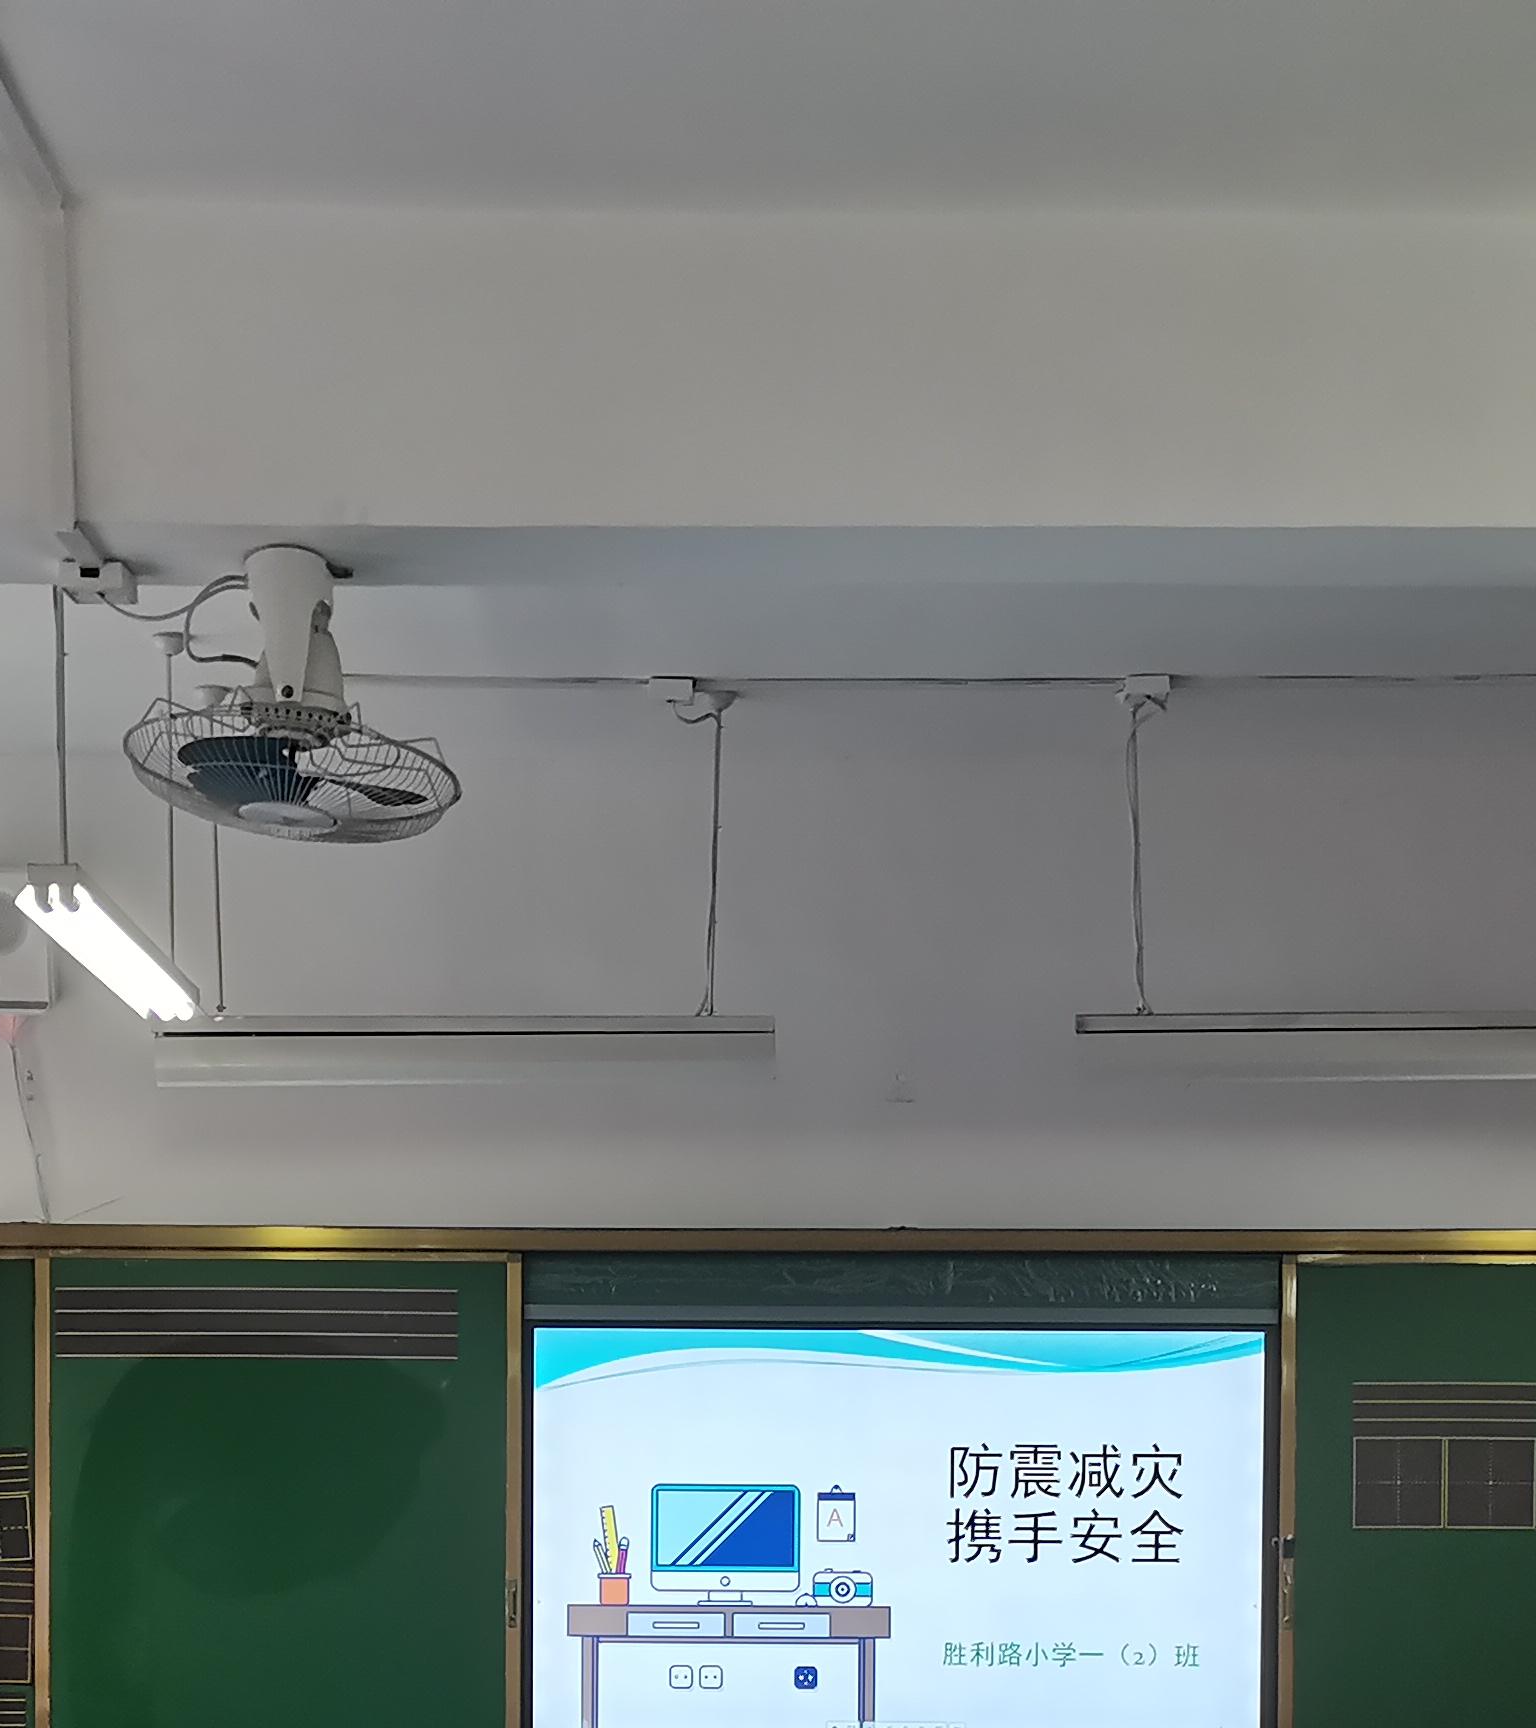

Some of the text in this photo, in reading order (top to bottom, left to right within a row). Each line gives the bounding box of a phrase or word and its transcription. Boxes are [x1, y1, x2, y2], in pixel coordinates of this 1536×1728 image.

[949, 1442, 1184, 1499] 防震减灾
[826, 1507, 844, 1528] A
[946, 1508, 1185, 1564] 携手安全
